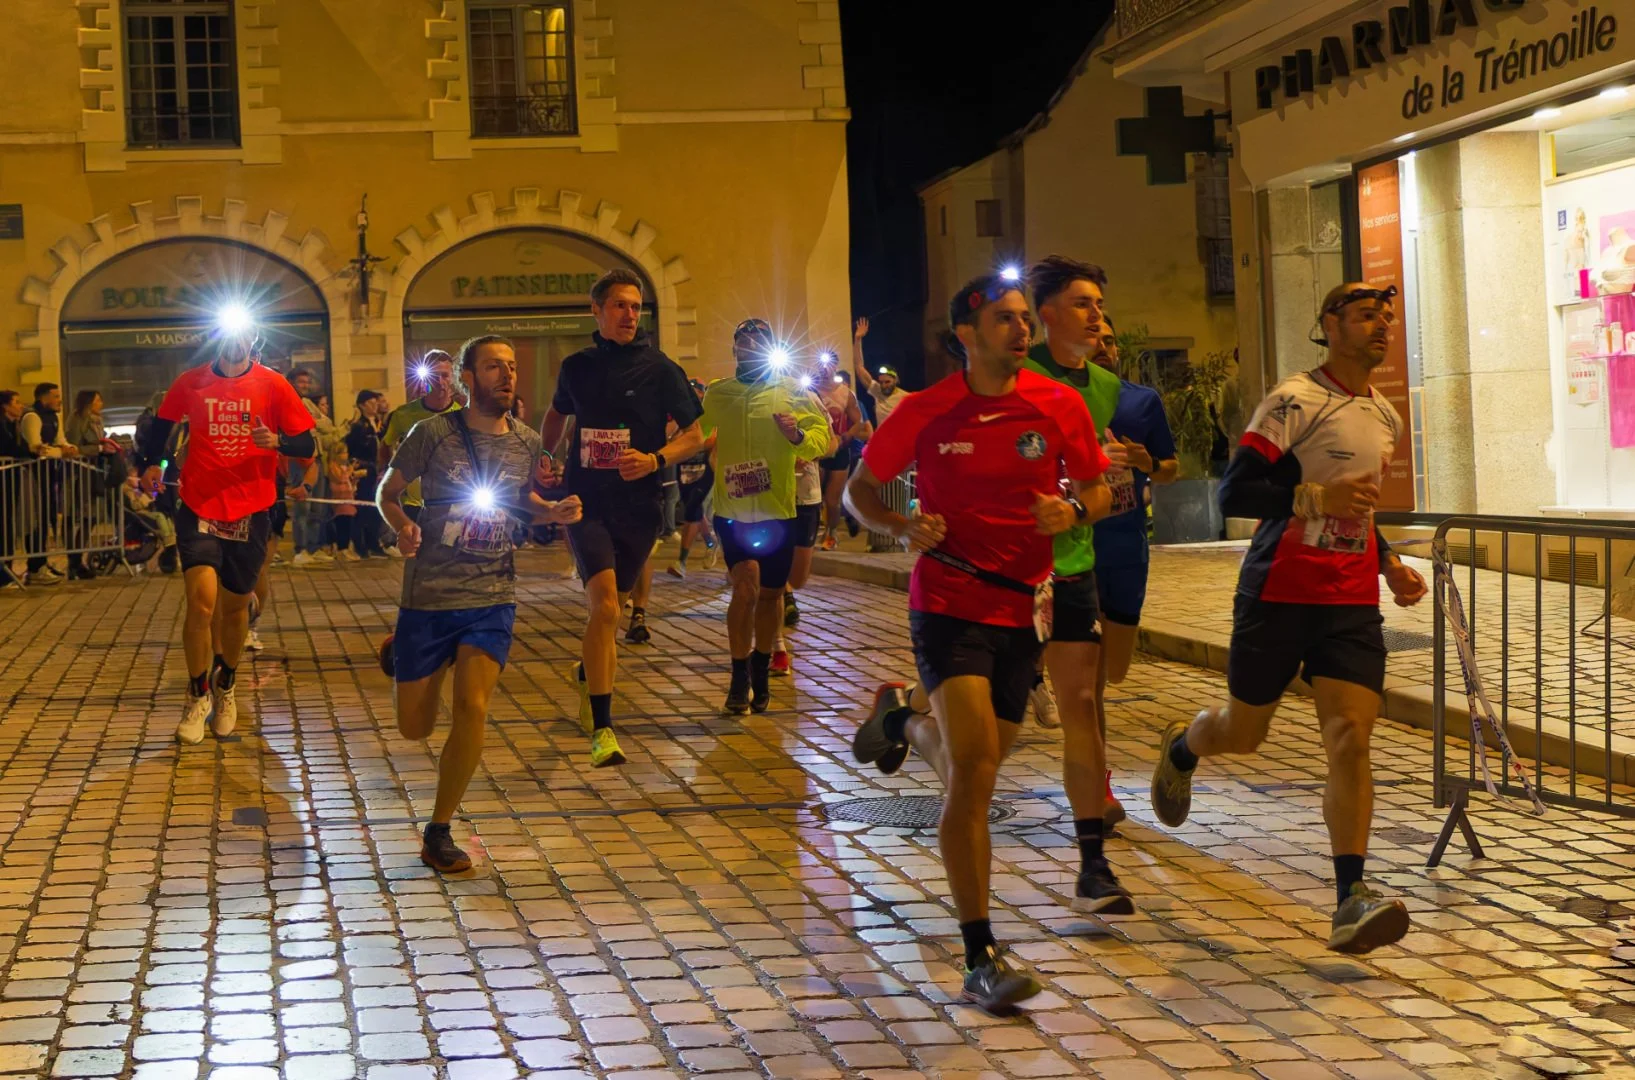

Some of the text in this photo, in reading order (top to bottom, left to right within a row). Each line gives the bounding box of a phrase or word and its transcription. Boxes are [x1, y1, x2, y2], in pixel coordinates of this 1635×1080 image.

[1256, 0, 1525, 109] PHARMA
[1402, 6, 1616, 119] de la Trémoille
[136, 334, 152, 345] LA
[204, 398, 251, 422] Trail
[217, 413, 238, 422] des
[209, 423, 251, 436] BOSS
